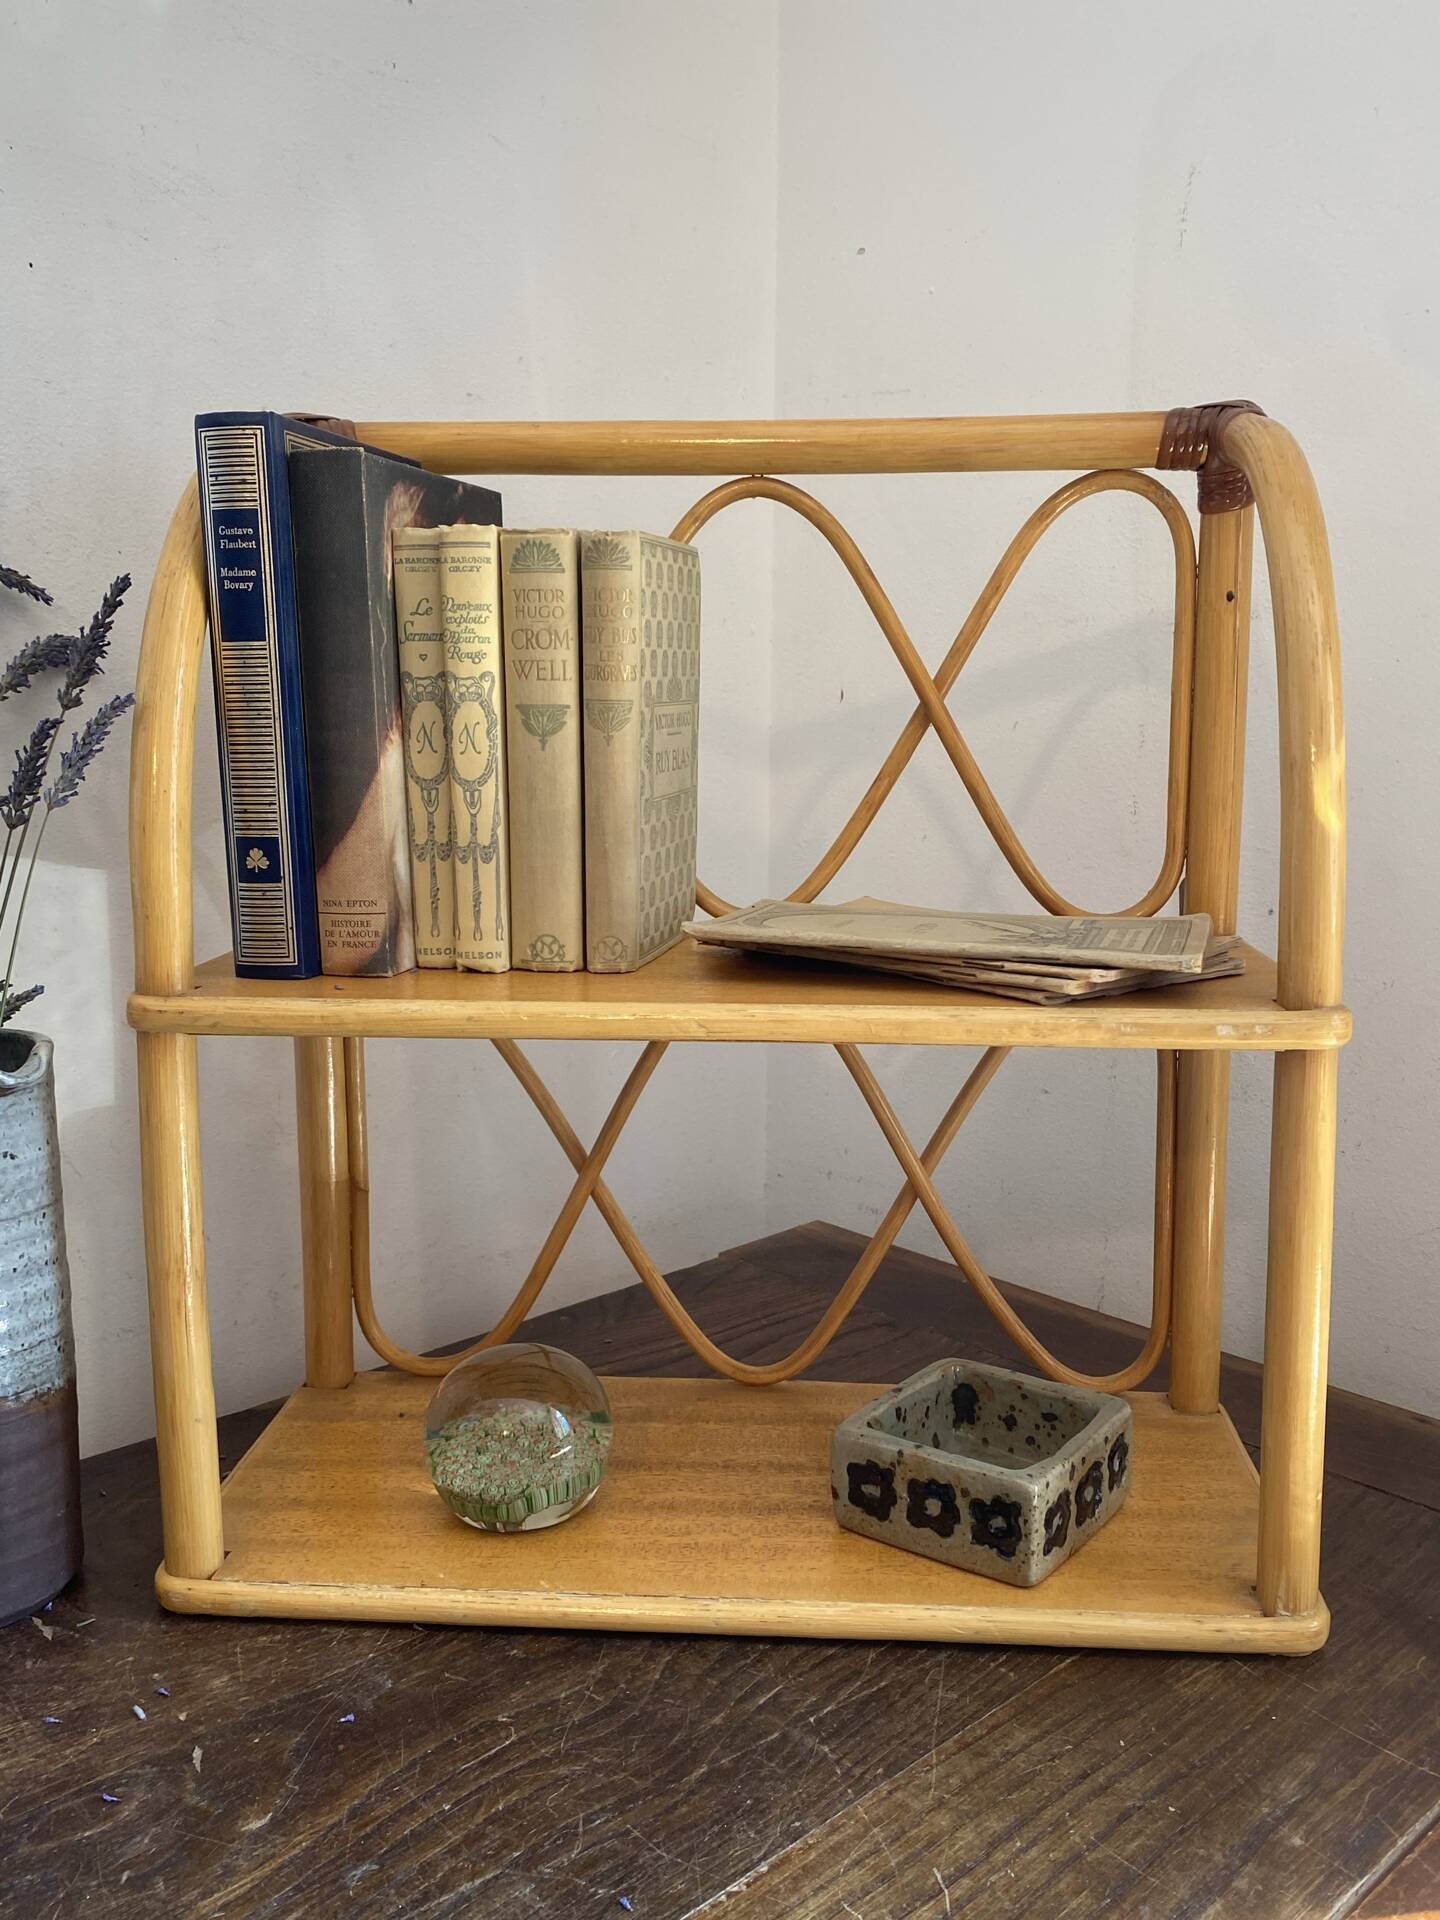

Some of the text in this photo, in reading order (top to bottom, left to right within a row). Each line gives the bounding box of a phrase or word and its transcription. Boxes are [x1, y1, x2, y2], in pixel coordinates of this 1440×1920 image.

[219, 525, 253, 535] Gustave
[220, 539, 256, 549] Flaubert
[394, 556, 404, 565] LA
[450, 555, 492, 565] BARONNE
[220, 567, 256, 577] Madame
[448, 565, 482, 573] ORCZY
[224, 580, 253, 591] Bovary
[512, 588, 566, 603] VICTOR
[410, 598, 433, 616] Le
[441, 595, 492, 613] Nouveaux
[515, 605, 565, 619] HUGO
[446, 612, 489, 627] exploits
[447, 645, 487, 664] Rouge
[512, 659, 572, 681] WELL
[323, 899, 378, 908] NINA EPTON
[331, 919, 372, 929] HISTOIRE
[324, 930, 381, 939] DE L'AMOUR
[327, 940, 377, 949] EN FRANCE
[457, 950, 503, 961] NELSON
